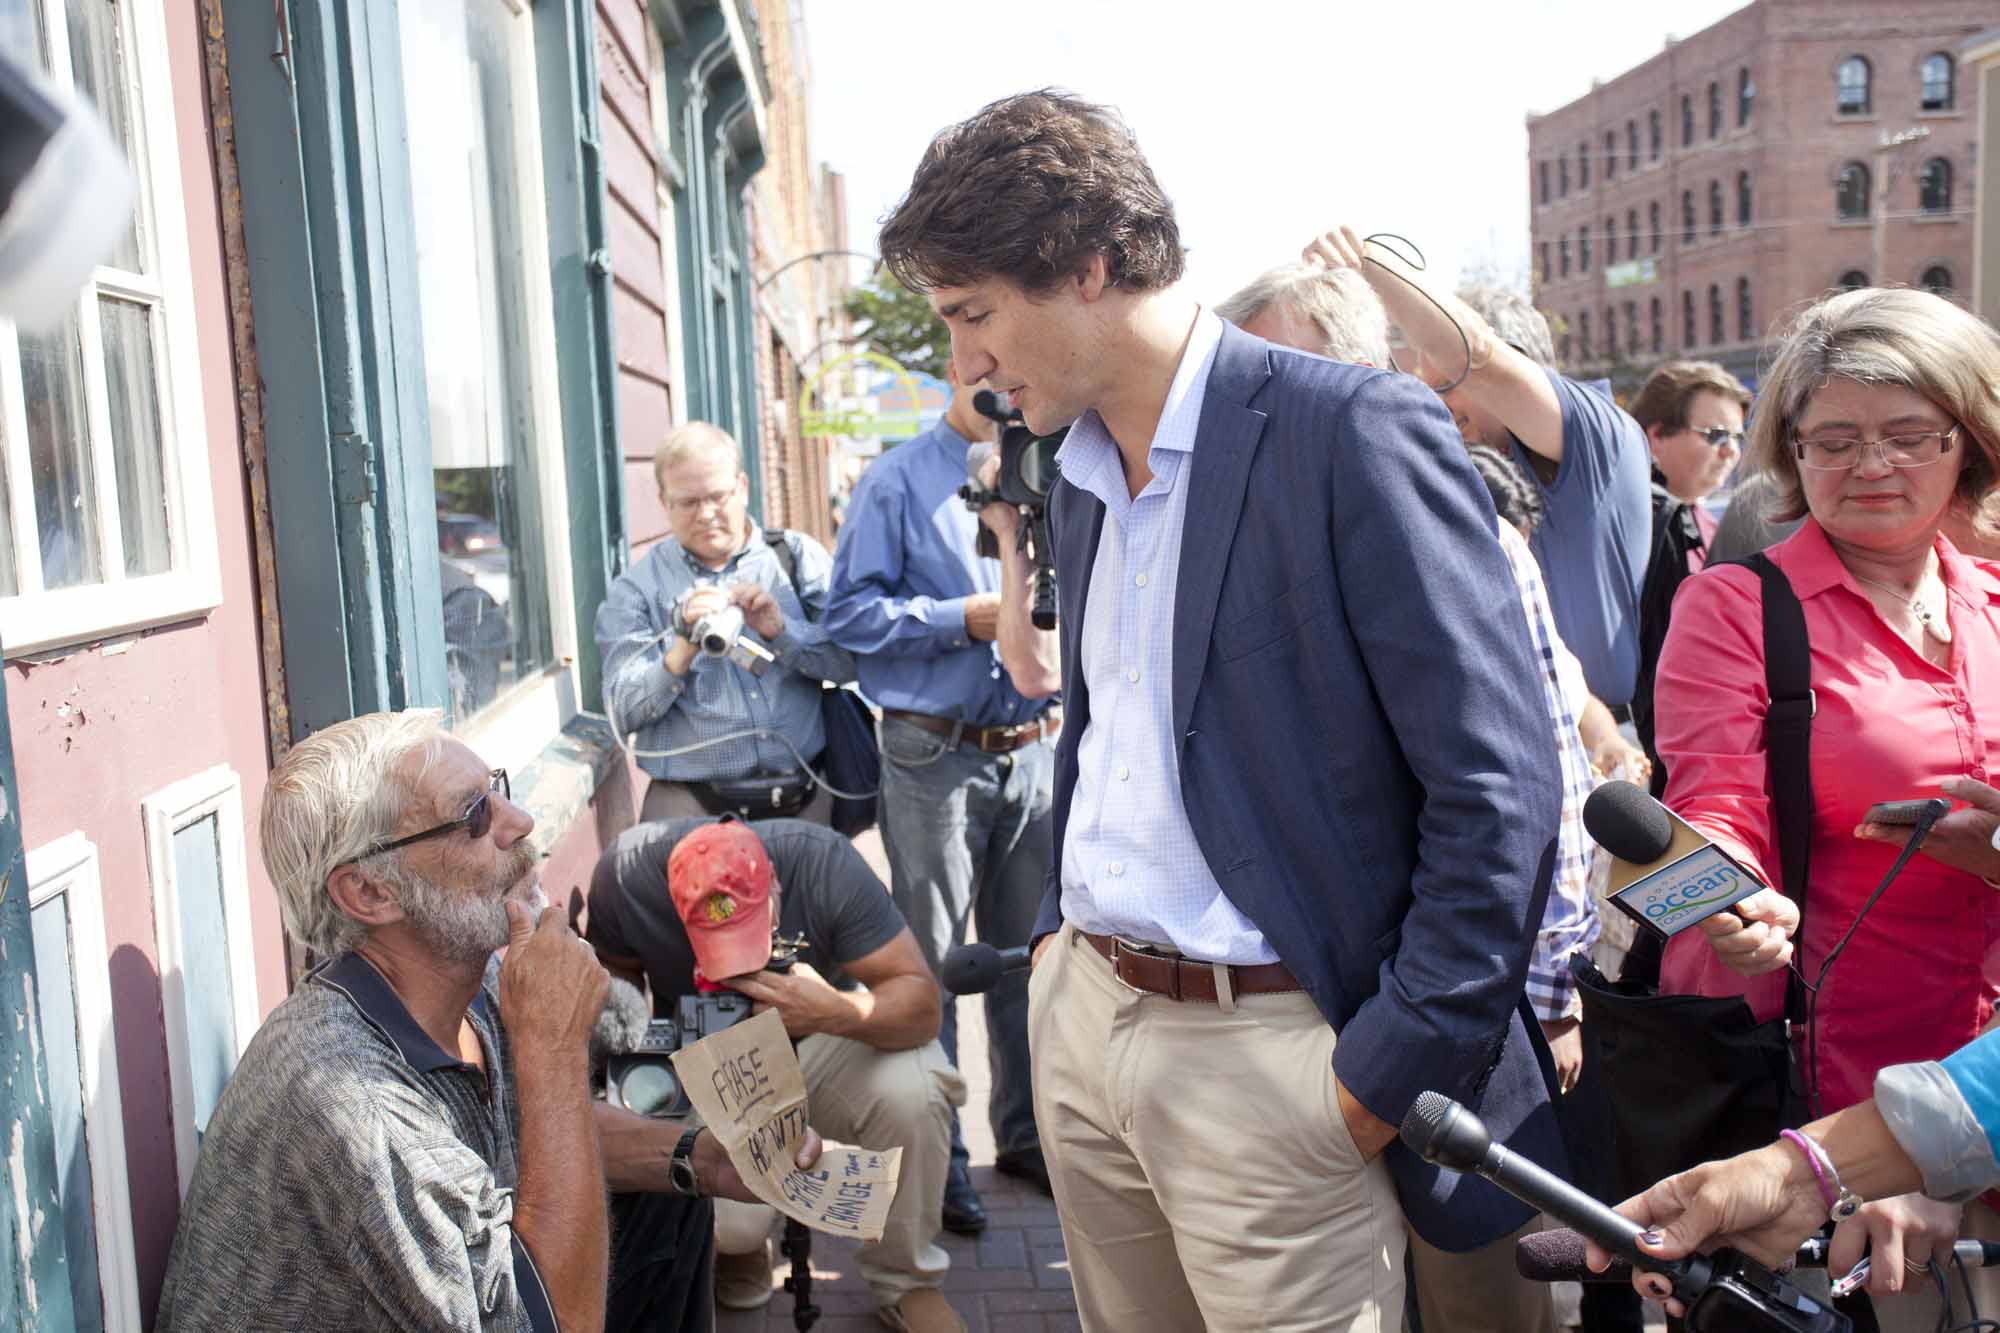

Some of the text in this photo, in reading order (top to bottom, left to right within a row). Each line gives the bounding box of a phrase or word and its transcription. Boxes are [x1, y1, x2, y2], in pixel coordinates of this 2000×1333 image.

[1646, 867, 1740, 917] ocean
[711, 1046, 768, 1113] PEASE
[820, 1181, 873, 1231] CHANGE
